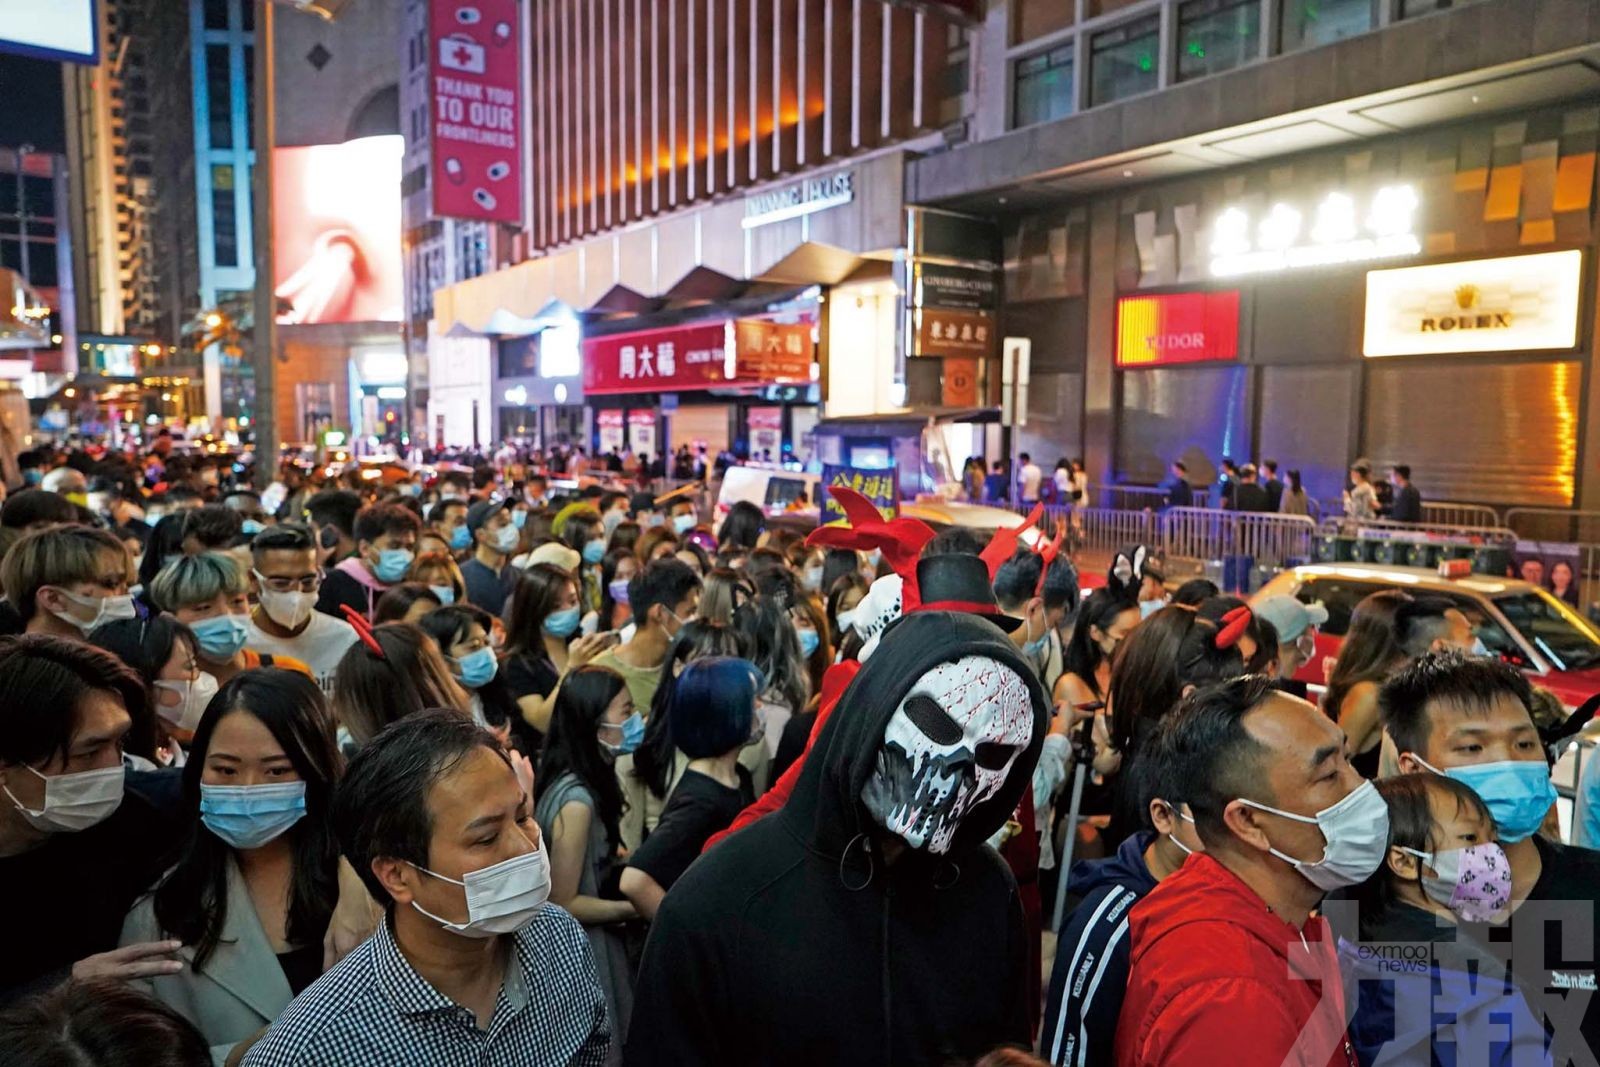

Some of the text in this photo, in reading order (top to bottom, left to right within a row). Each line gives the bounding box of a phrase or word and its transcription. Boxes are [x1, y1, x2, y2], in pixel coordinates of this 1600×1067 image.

[436, 76, 514, 106] THANK YOU
[436, 95, 514, 131] TO OUR
[436, 123, 515, 149] FRONTLINERS
[1421, 311, 1512, 331] ROLEX
[1145, 332, 1205, 350] TUDOR
[618, 341, 676, 379] 周大福
